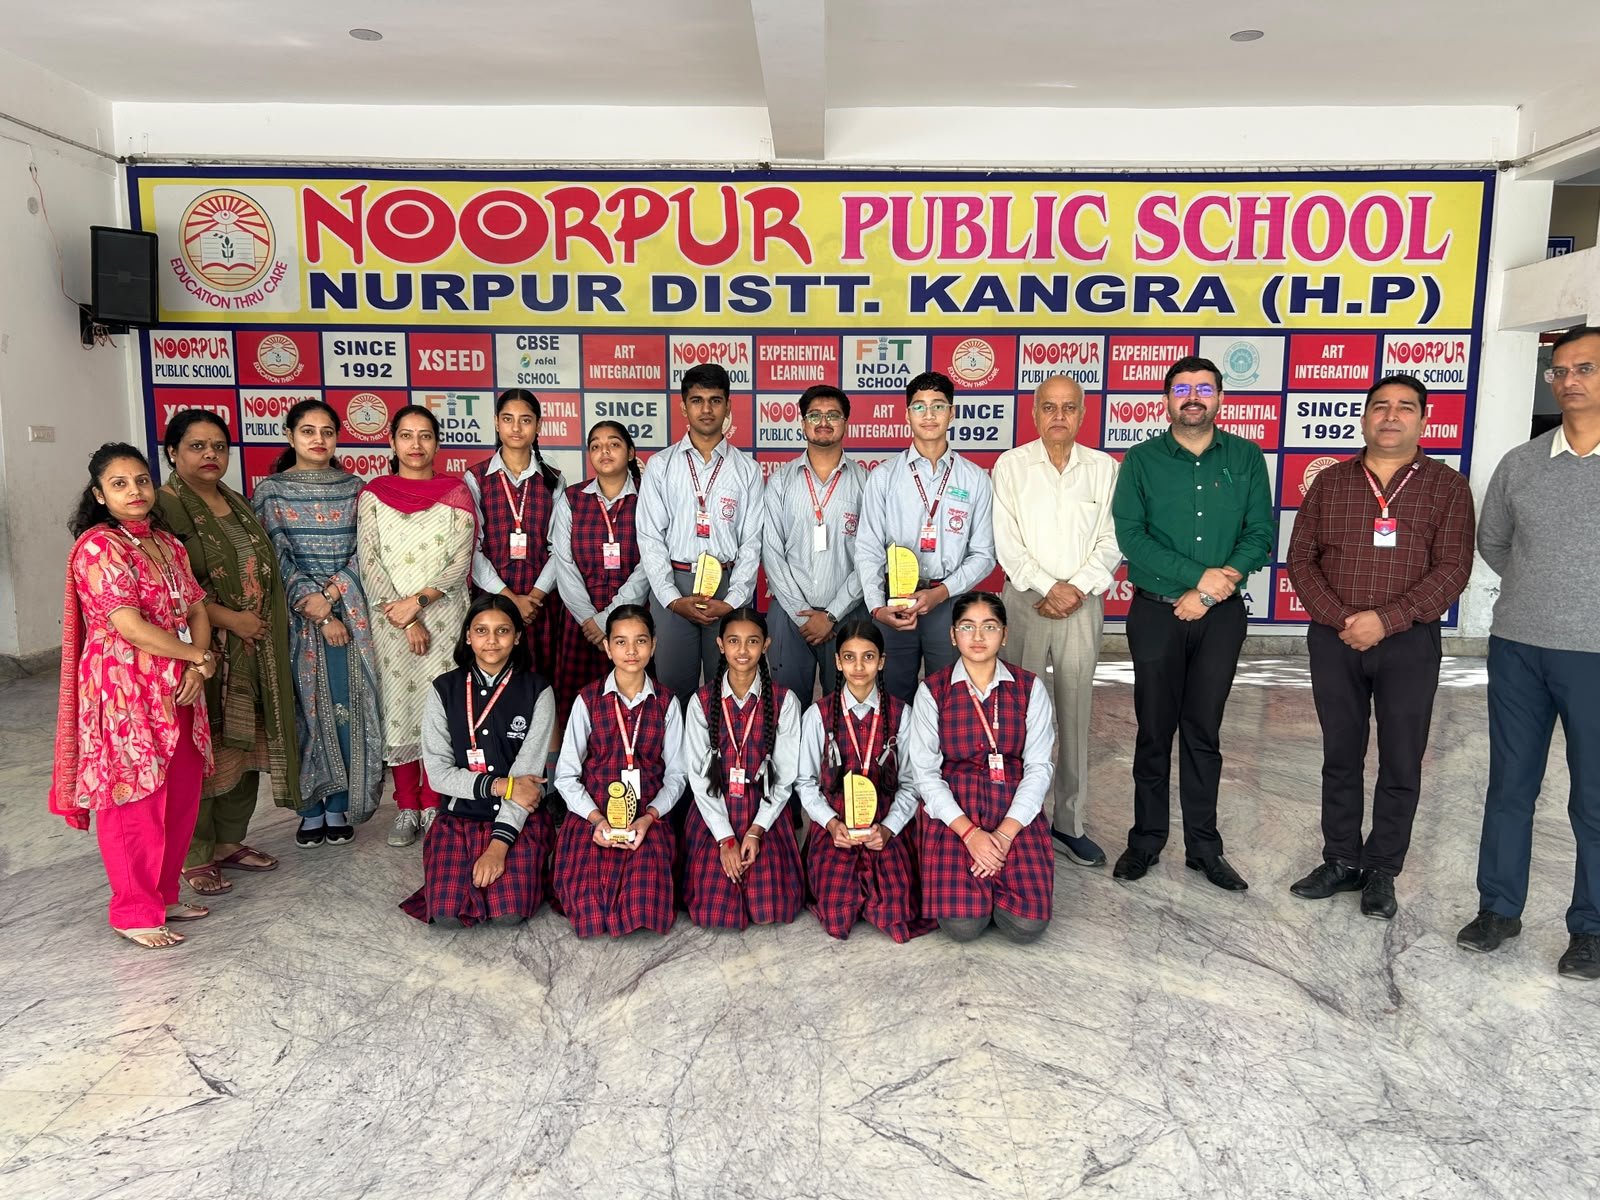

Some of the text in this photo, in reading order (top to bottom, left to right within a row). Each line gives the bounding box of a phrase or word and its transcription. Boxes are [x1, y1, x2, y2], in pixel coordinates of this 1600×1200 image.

[303, 185, 1447, 266] NOORPUR PUBLIC SCHOOL
[171, 258, 288, 309] EDUCATION THRU CARE
[309, 272, 1441, 325] NURPUR DISTT. KANGRA (H.P)
[153, 336, 230, 360] NOORPUR
[333, 340, 397, 356] SINCE
[516, 335, 560, 351] CBSE
[418, 349, 486, 371] XSEED
[614, 345, 636, 359] ART
[673, 341, 749, 365] NOORPUR
[759, 345, 837, 361] EXPERIENTIAL
[1023, 341, 1100, 365] NOORPUR
[1321, 345, 1345, 359] ART
[1386, 341, 1465, 365] NOORPUR
[155, 364, 232, 380] PUBLIC SCHOOL
[340, 362, 393, 378] 1992
[589, 365, 661, 379] INTEGRATION
[770, 365, 825, 381] LEARNING
[855, 363, 911, 375] INDIA
[1294, 365, 1369, 379] INTEGRATION
[1423, 370, 1464, 383] SCHOOL
[517, 372, 561, 385] SCHOOL
[947, 366, 1000, 390] EDUCATION THRU CARE
[540, 402, 579, 418] ENTIAL
[594, 401, 658, 417] SINCE
[872, 404, 895, 419] ART
[954, 404, 1005, 419] INCE
[1109, 401, 1172, 424] NOORP
[1297, 402, 1362, 418] SINCE
[245, 422, 280, 436] PUBLIC
[342, 420, 370, 442] EDUCATION
[438, 418, 481, 430] NDIA
[627, 424, 654, 439] 92
[848, 424, 914, 438] INTEGRATIO
[1301, 424, 1356, 439] 1992
[439, 431, 482, 443] CHOOL
[759, 428, 794, 441] PUBLIC
[948, 426, 999, 441] 1992
[1108, 428, 1143, 441] PUBLIC
[446, 459, 467, 473] ART
